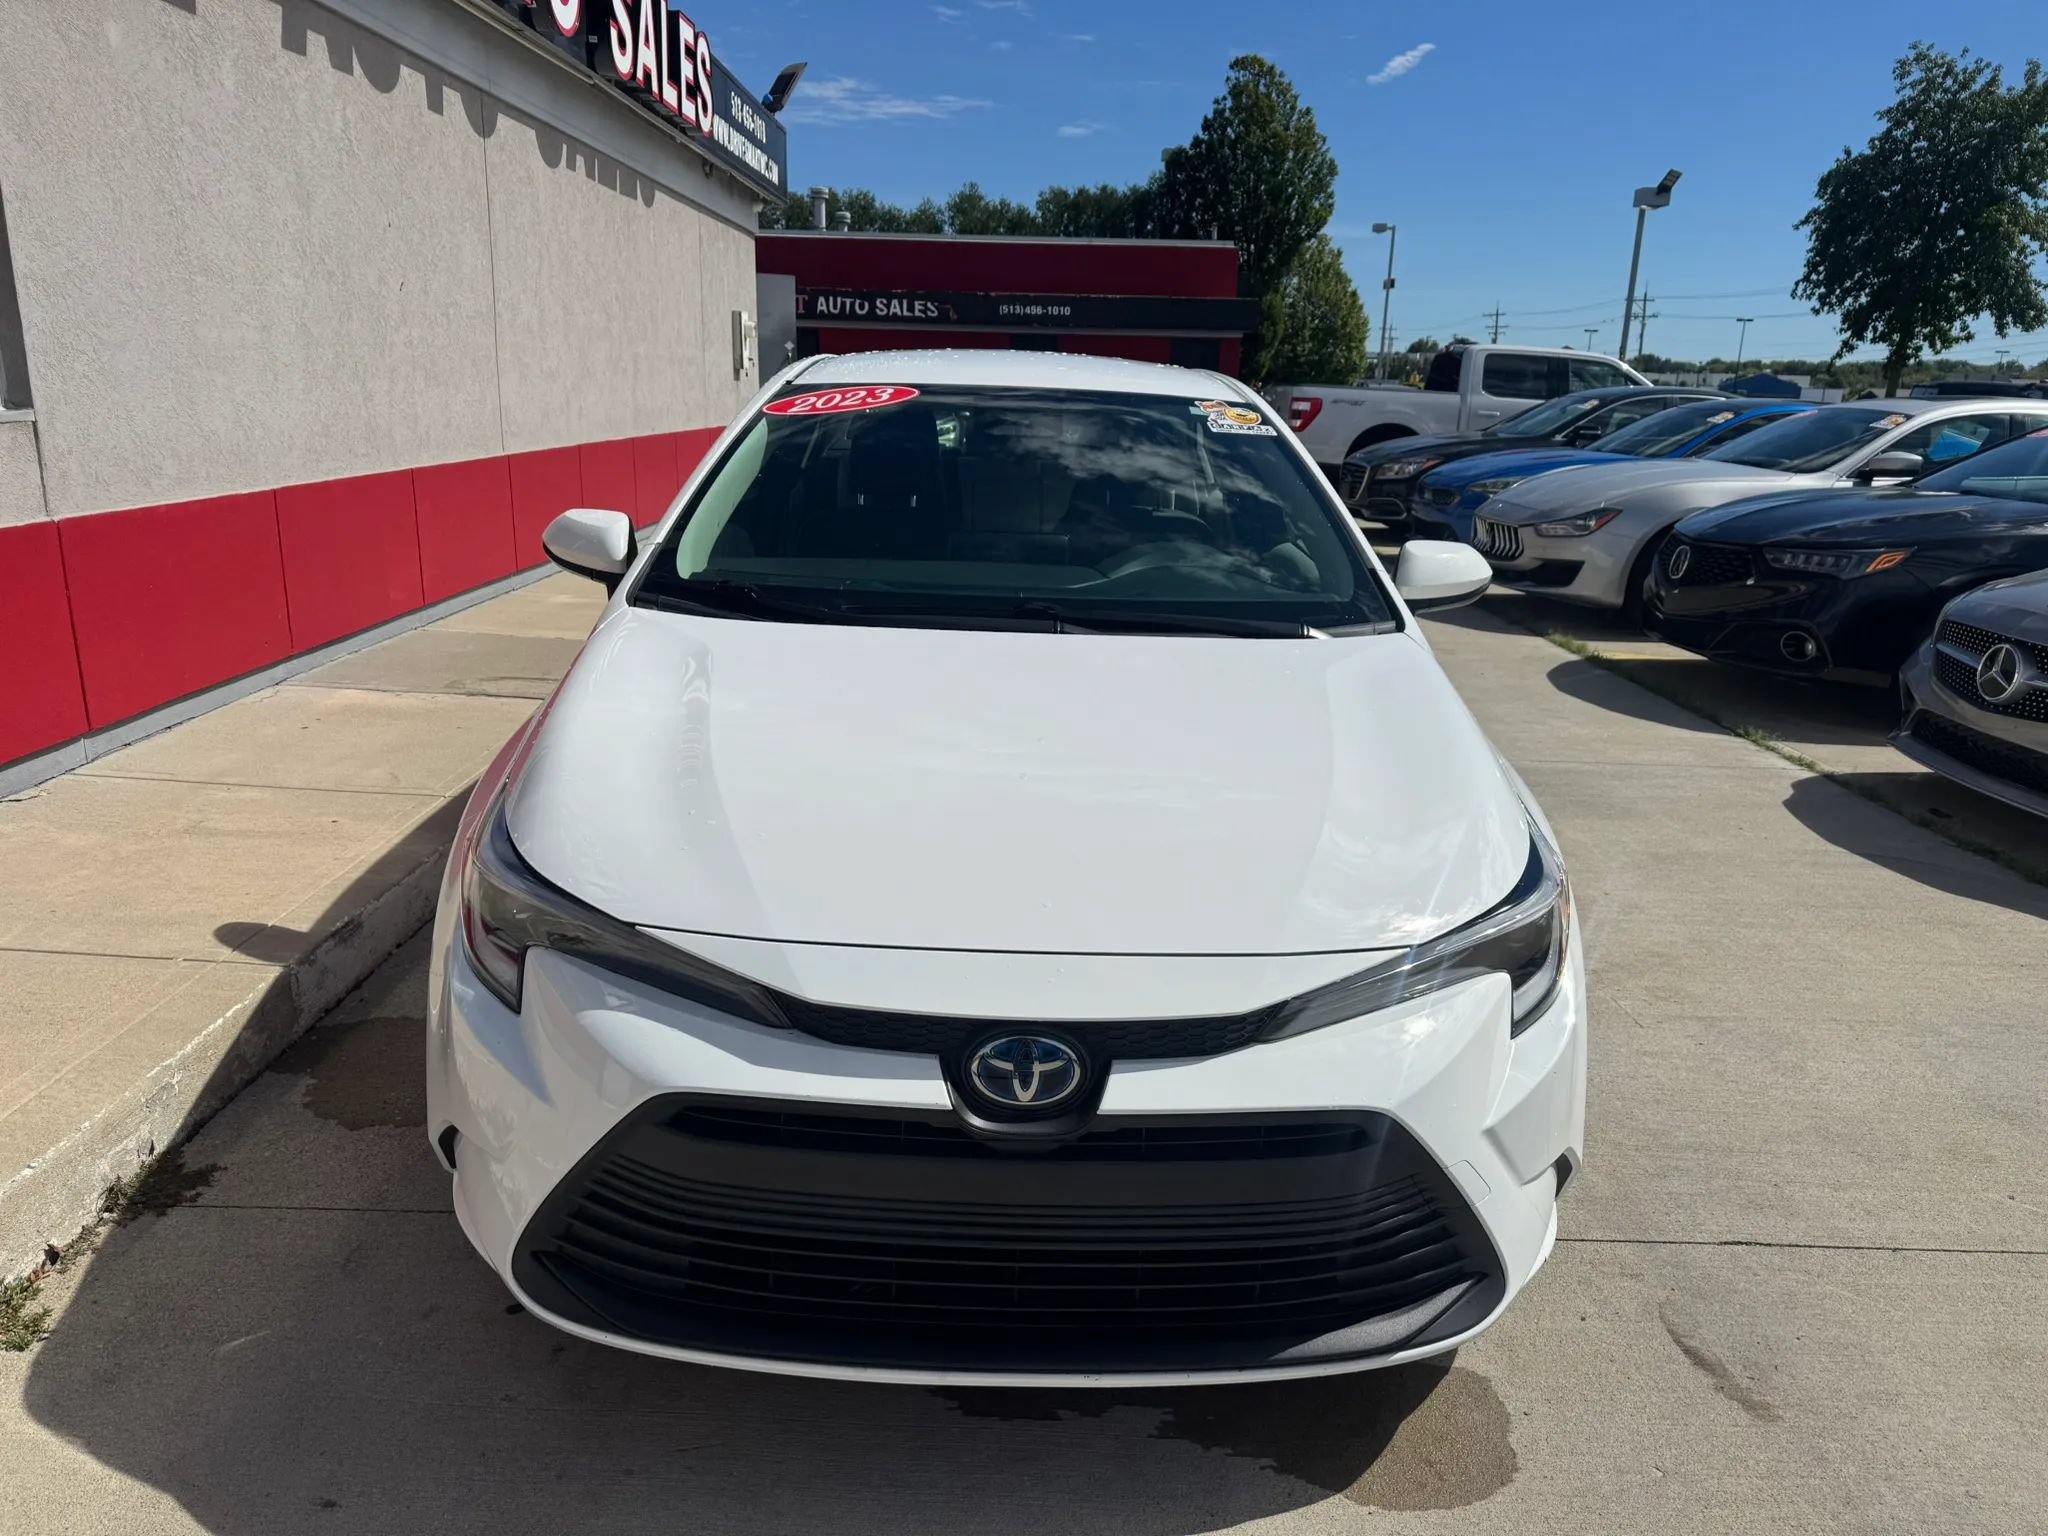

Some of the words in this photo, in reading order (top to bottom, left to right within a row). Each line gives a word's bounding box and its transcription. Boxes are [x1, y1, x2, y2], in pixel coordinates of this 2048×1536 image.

[609, 0, 713, 137] SALES
[816, 296, 869, 315] AUTO
[875, 298, 939, 318] SALES
[786, 388, 895, 413] 2023
